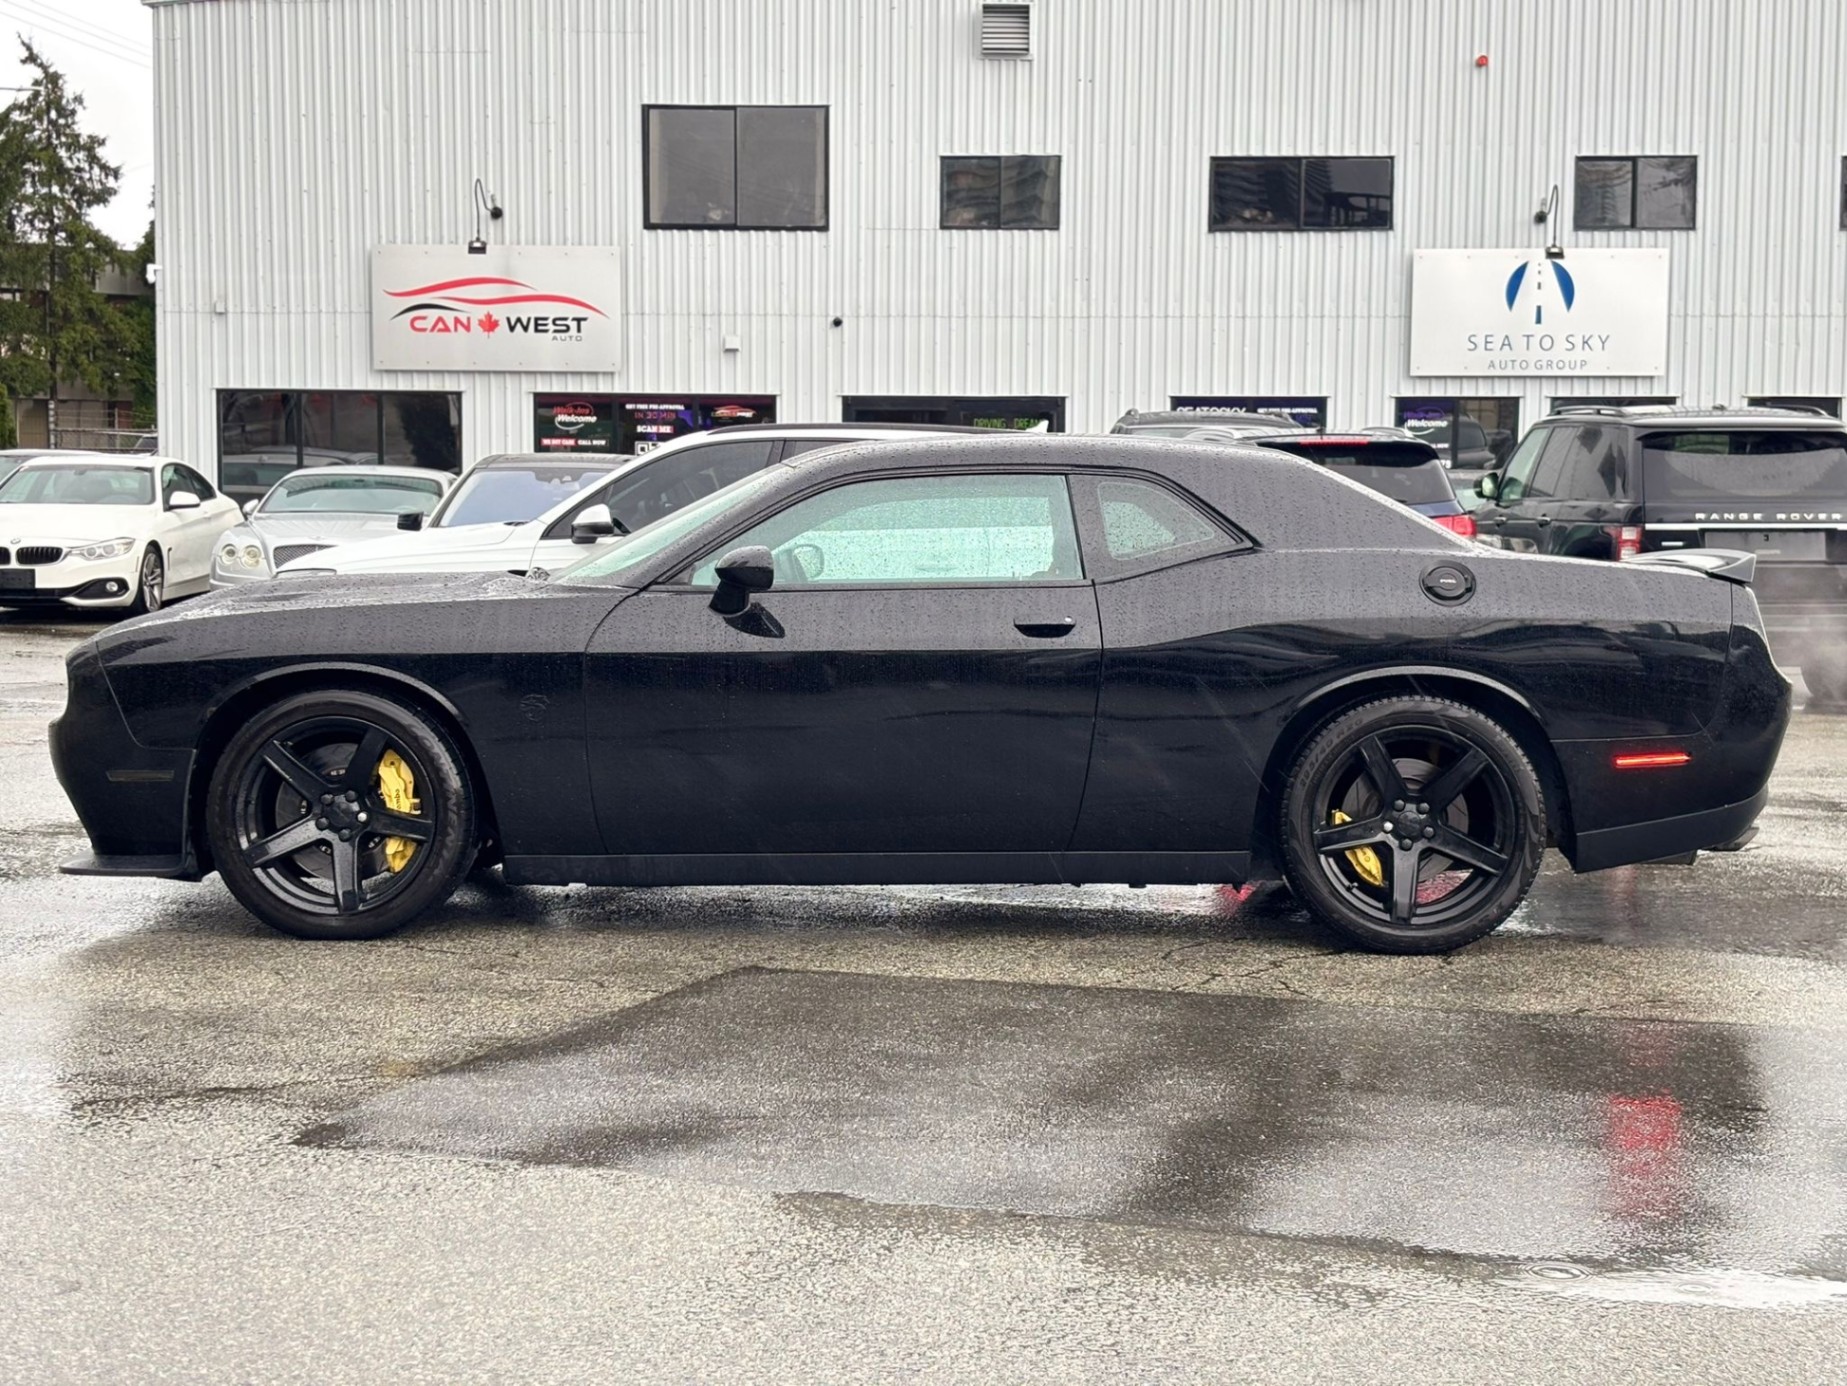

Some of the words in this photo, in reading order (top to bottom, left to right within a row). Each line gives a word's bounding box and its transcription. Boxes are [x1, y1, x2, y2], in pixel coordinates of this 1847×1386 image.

[409, 315, 471, 333] CAN
[506, 316, 588, 334] WEST
[1467, 334, 1513, 352] SEA
[1522, 334, 1554, 352] TO
[1564, 334, 1610, 352] SKY
[1487, 359, 1529, 370] AUTO
[1533, 359, 1588, 370] GROUP
[557, 414, 597, 423] Welcome
[1407, 419, 1448, 428] Welcome
[1695, 513, 1762, 521] RANGE
[1776, 513, 1842, 521] ROVER
